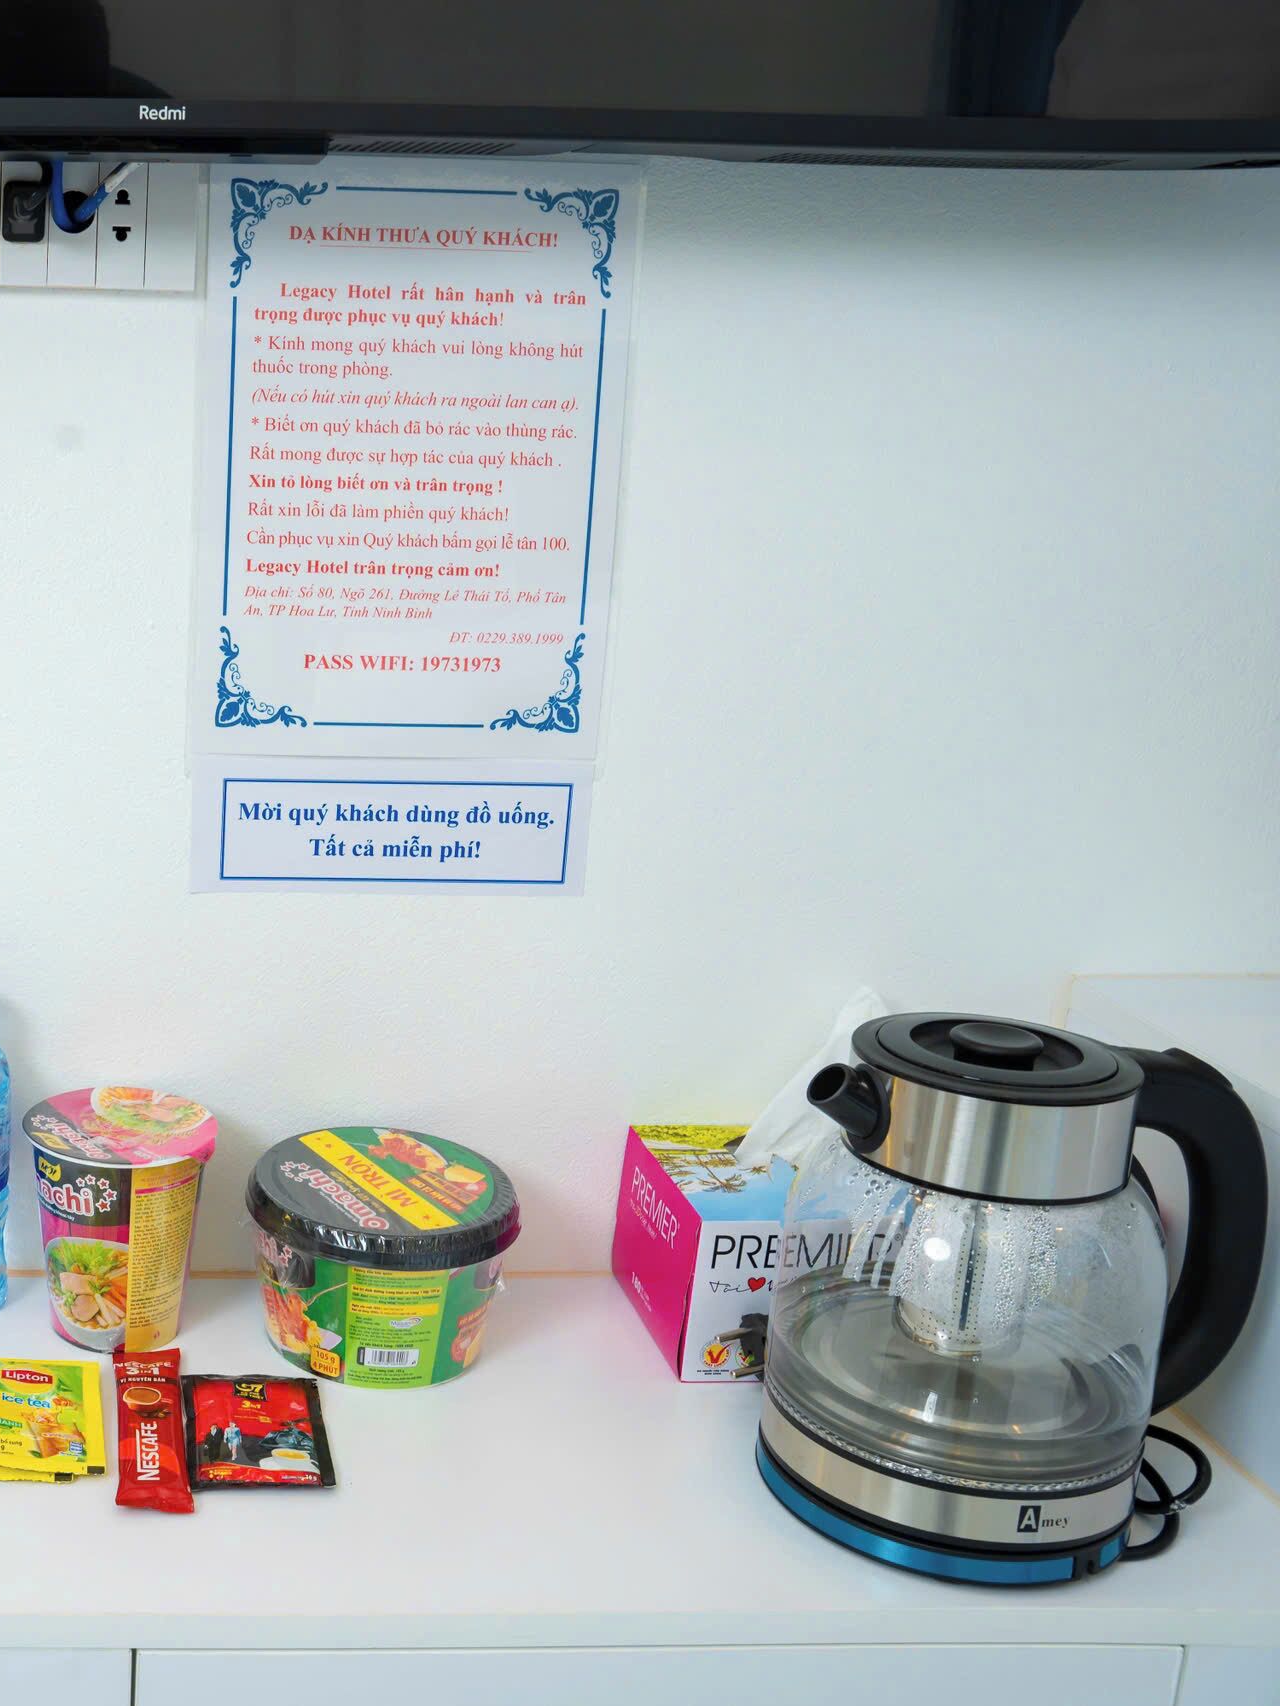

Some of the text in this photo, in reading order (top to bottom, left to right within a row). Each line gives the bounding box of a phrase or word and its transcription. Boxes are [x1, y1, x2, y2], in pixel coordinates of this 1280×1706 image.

[139, 105, 186, 121] Redmi
[289, 223, 558, 250] DẠ KÍNH THƯA QUÝ KHÁCH!
[280, 282, 587, 307] Legacy Hotel rất hân hạnh và trân
[255, 306, 502, 329] trọng được phục vụ quý khách!
[267, 335, 306, 353] Kính
[311, 336, 353, 357] mong
[359, 340, 386, 358] quý
[391, 336, 437, 355] khách
[442, 341, 465, 356] vui
[469, 339, 503, 360] lòng
[506, 341, 555, 362] không
[251, 356, 394, 380] thuốc trong phòng.
[265, 414, 295, 433] Biết
[300, 419, 321, 433] ơn
[323, 417, 351, 438] quý
[354, 416, 400, 436] khách
[404, 419, 421, 437] đã
[448, 421, 470, 437] rác
[474, 424, 502, 438] vào
[505, 421, 548, 442] thùng
[550, 423, 579, 440] rác.
[249, 442, 276, 462] Rất
[280, 447, 322, 466] mong
[326, 446, 363, 465] được
[368, 451, 386, 465] sự
[389, 447, 419, 469] hợp
[422, 448, 444, 465] tác
[478, 453, 506, 470] quý
[509, 449, 554, 468] khách
[249, 474, 276, 490] Xin
[299, 474, 333, 494] lòng
[337, 474, 365, 492] biết
[369, 479, 389, 491] ơn
[394, 477, 411, 493] và
[415, 477, 448, 493] trân
[452, 480, 493, 497] trọng
[247, 498, 273, 517] Rất
[330, 503, 348, 520] đã
[352, 503, 380, 520] làm
[383, 501, 424, 523] phiền
[428, 507, 456, 524] quý
[460, 504, 509, 522] khách!
[246, 528, 276, 545] Cần
[278, 530, 314, 549] phục
[317, 533, 335, 548] vụ
[363, 531, 393, 552] Quý
[396, 531, 440, 549] khách
[442, 531, 472, 550] bấm
[475, 536, 498, 554] gọi
[516, 536, 538, 552] tân
[542, 535, 571, 553] 100.
[246, 559, 301, 577] Legacy
[307, 559, 349, 575] Hotel
[354, 560, 386, 577] trân
[390, 562, 434, 581] trọng
[474, 562, 500, 577] ơn!
[304, 654, 501, 673] PASS WIFI: 19731973
[238, 801, 555, 831] Mời quý khách dùng đồ uống.
[309, 834, 480, 865] Tất cả miễn phí!
[631, 1167, 676, 1249] PREMIER
[5, 1370, 49, 1383] Lipton
[1, 1392, 52, 1409] ice tea
